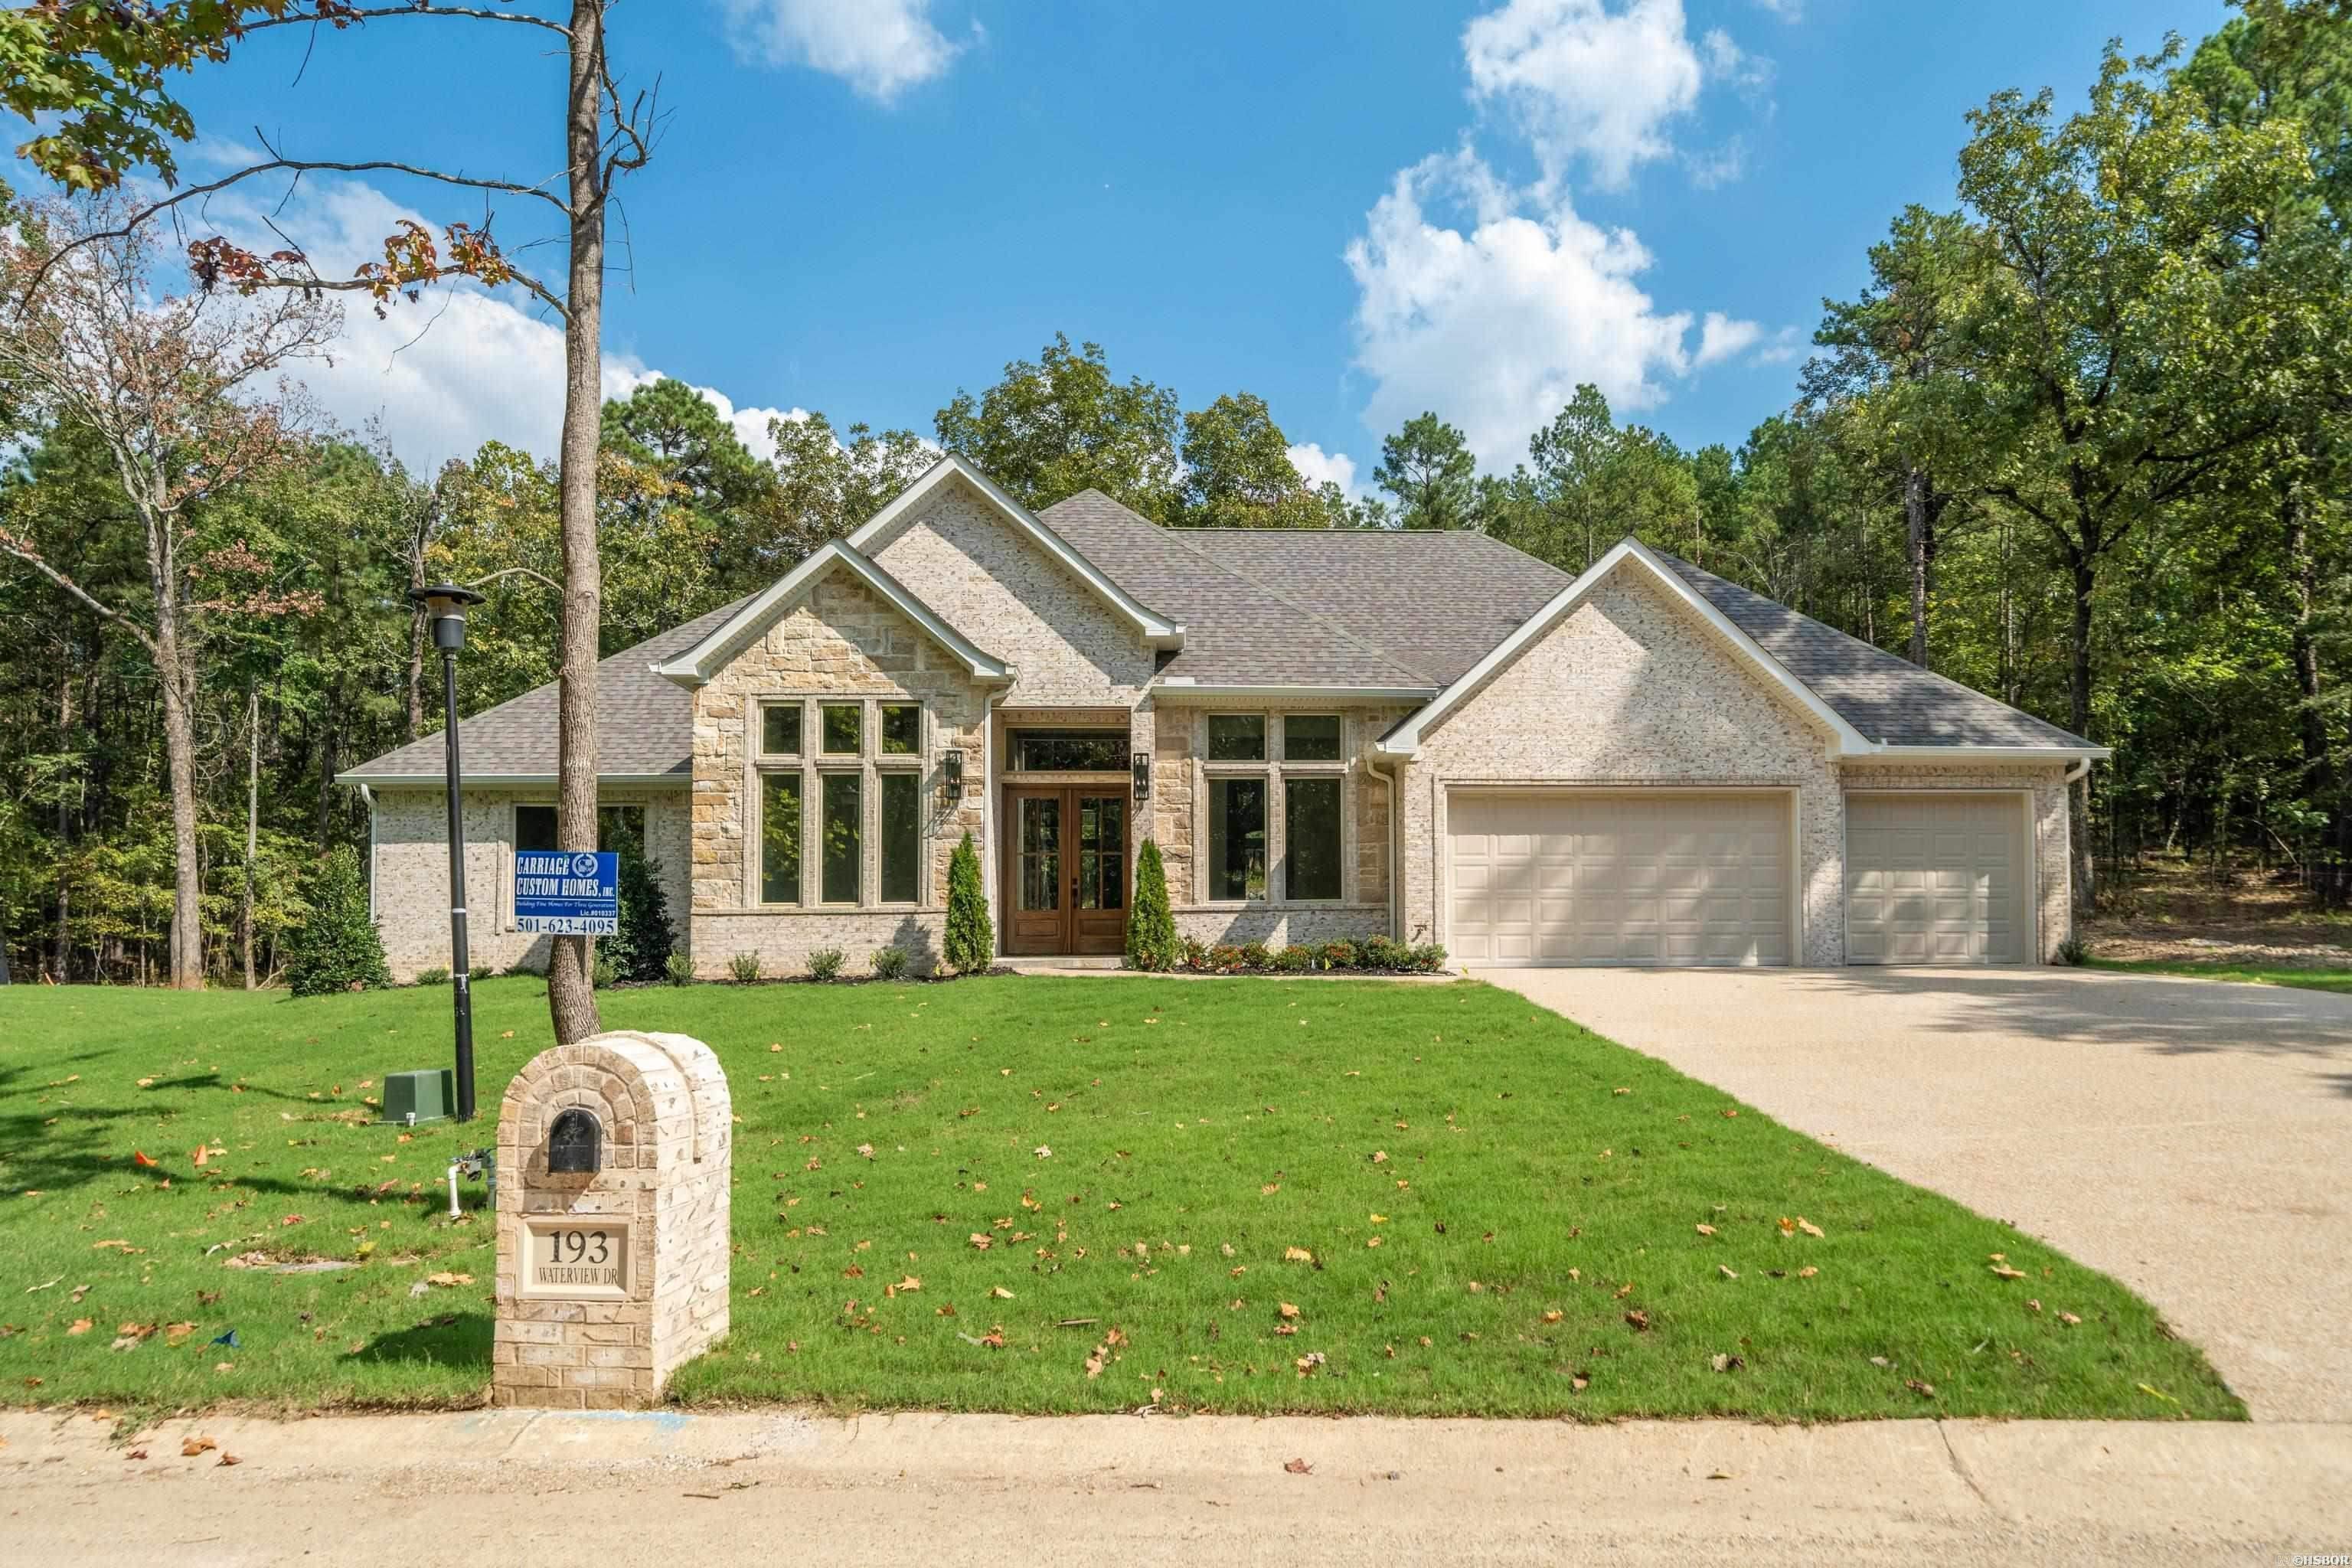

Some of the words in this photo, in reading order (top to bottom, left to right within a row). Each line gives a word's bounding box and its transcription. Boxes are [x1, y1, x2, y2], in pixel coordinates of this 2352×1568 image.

[516, 857, 570, 875] CARRIAGE
[516, 877, 558, 896] CUSTOM
[561, 878, 602, 897] HOMES,
[603, 887, 615, 897] INC.
[518, 919, 614, 934] 501-623-4095
[550, 1230, 609, 1263] 193
[539, 1267, 599, 1283] WATERVIEW
[603, 1268, 619, 1284] DR
